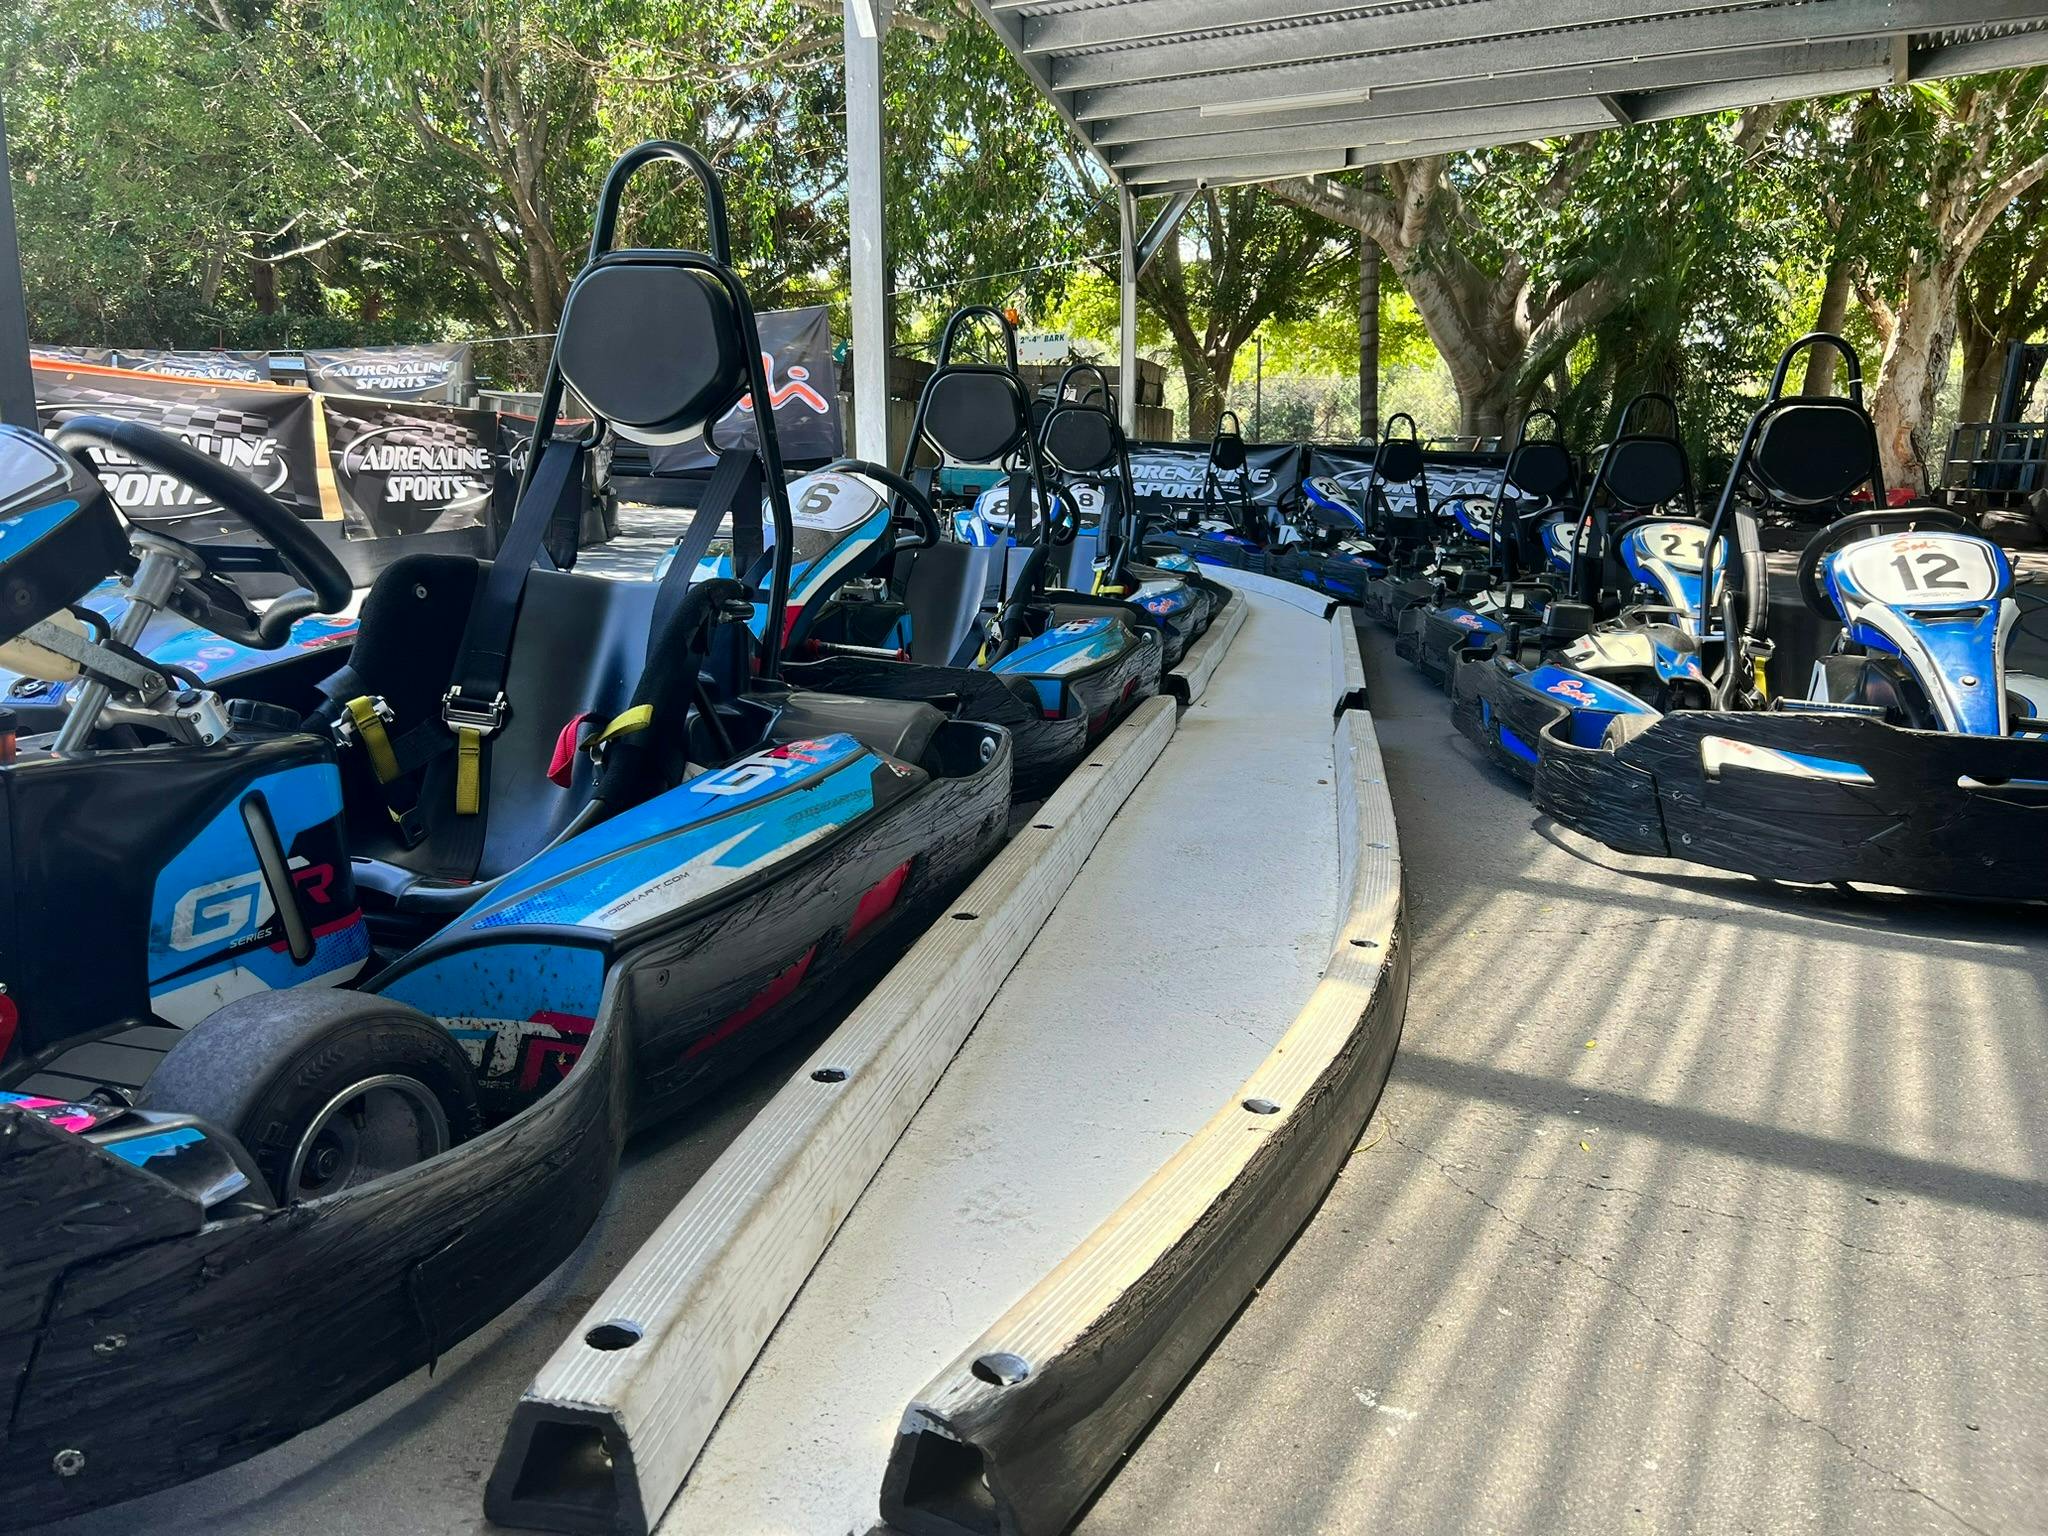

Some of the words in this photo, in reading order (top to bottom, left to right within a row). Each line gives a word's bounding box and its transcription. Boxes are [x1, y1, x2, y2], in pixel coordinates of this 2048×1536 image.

[1044, 334, 1065, 342] BARK
[333, 360, 454, 378] ADRENALINE
[355, 376, 428, 391] SPORTS
[359, 444, 492, 472] ADRENALINE
[97, 473, 214, 507] POR
[384, 473, 470, 503] SPORTS
[796, 482, 840, 514] 6
[1079, 493, 1094, 507] 8
[1319, 482, 1344, 495] 20
[1660, 534, 1706, 559] 21
[1889, 553, 1970, 591] 12
[229, 927, 273, 950] SERIES
